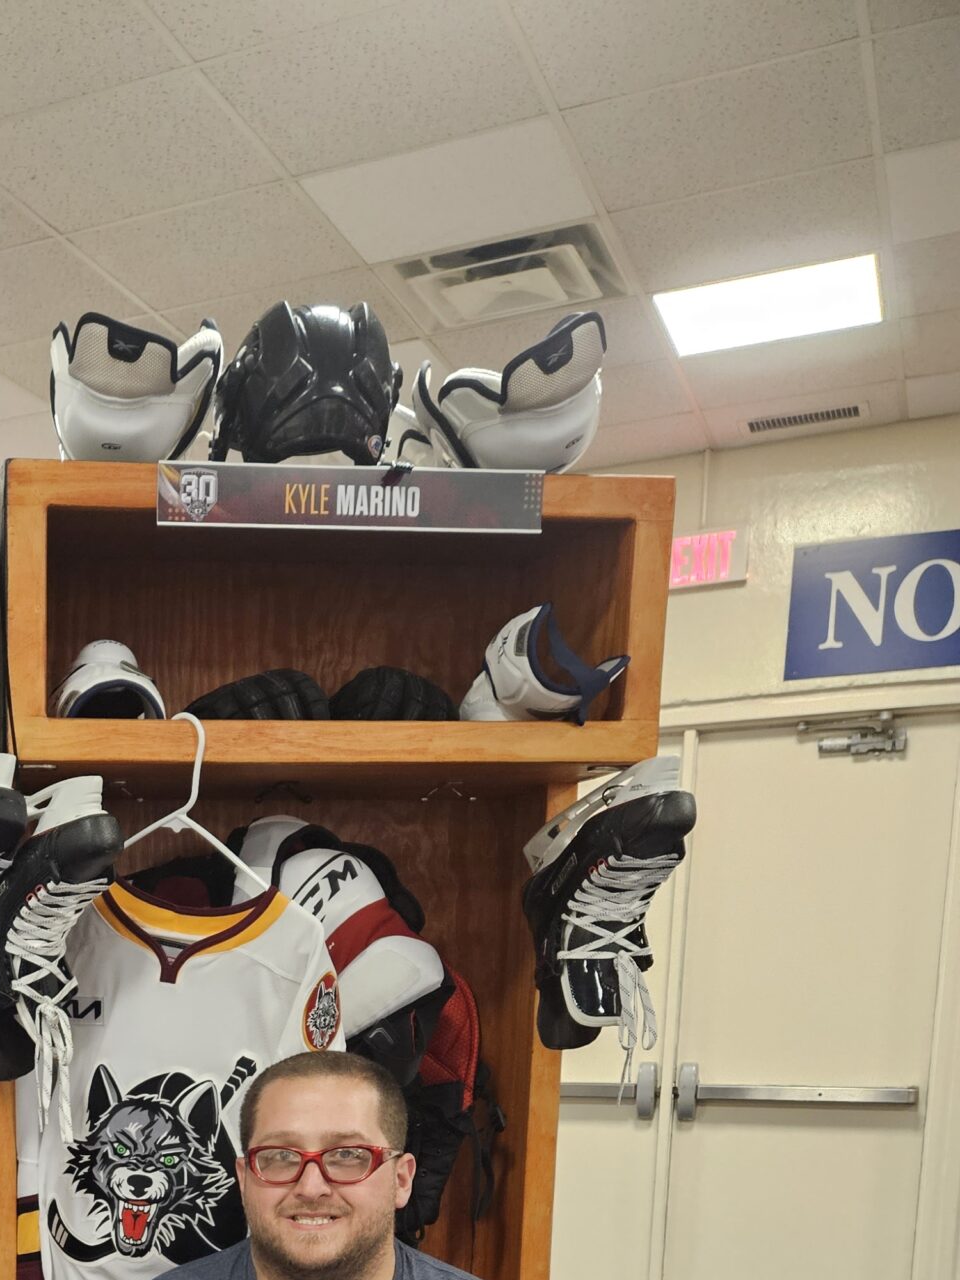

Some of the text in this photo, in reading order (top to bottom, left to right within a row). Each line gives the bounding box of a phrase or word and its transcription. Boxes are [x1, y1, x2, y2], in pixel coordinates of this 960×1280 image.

[181, 474, 216, 503] 30
[284, 483, 421, 518] KYLE MARINO
[671, 530, 737, 587] EXIT
[818, 558, 960, 650] NO
[299, 859, 359, 917] CM
